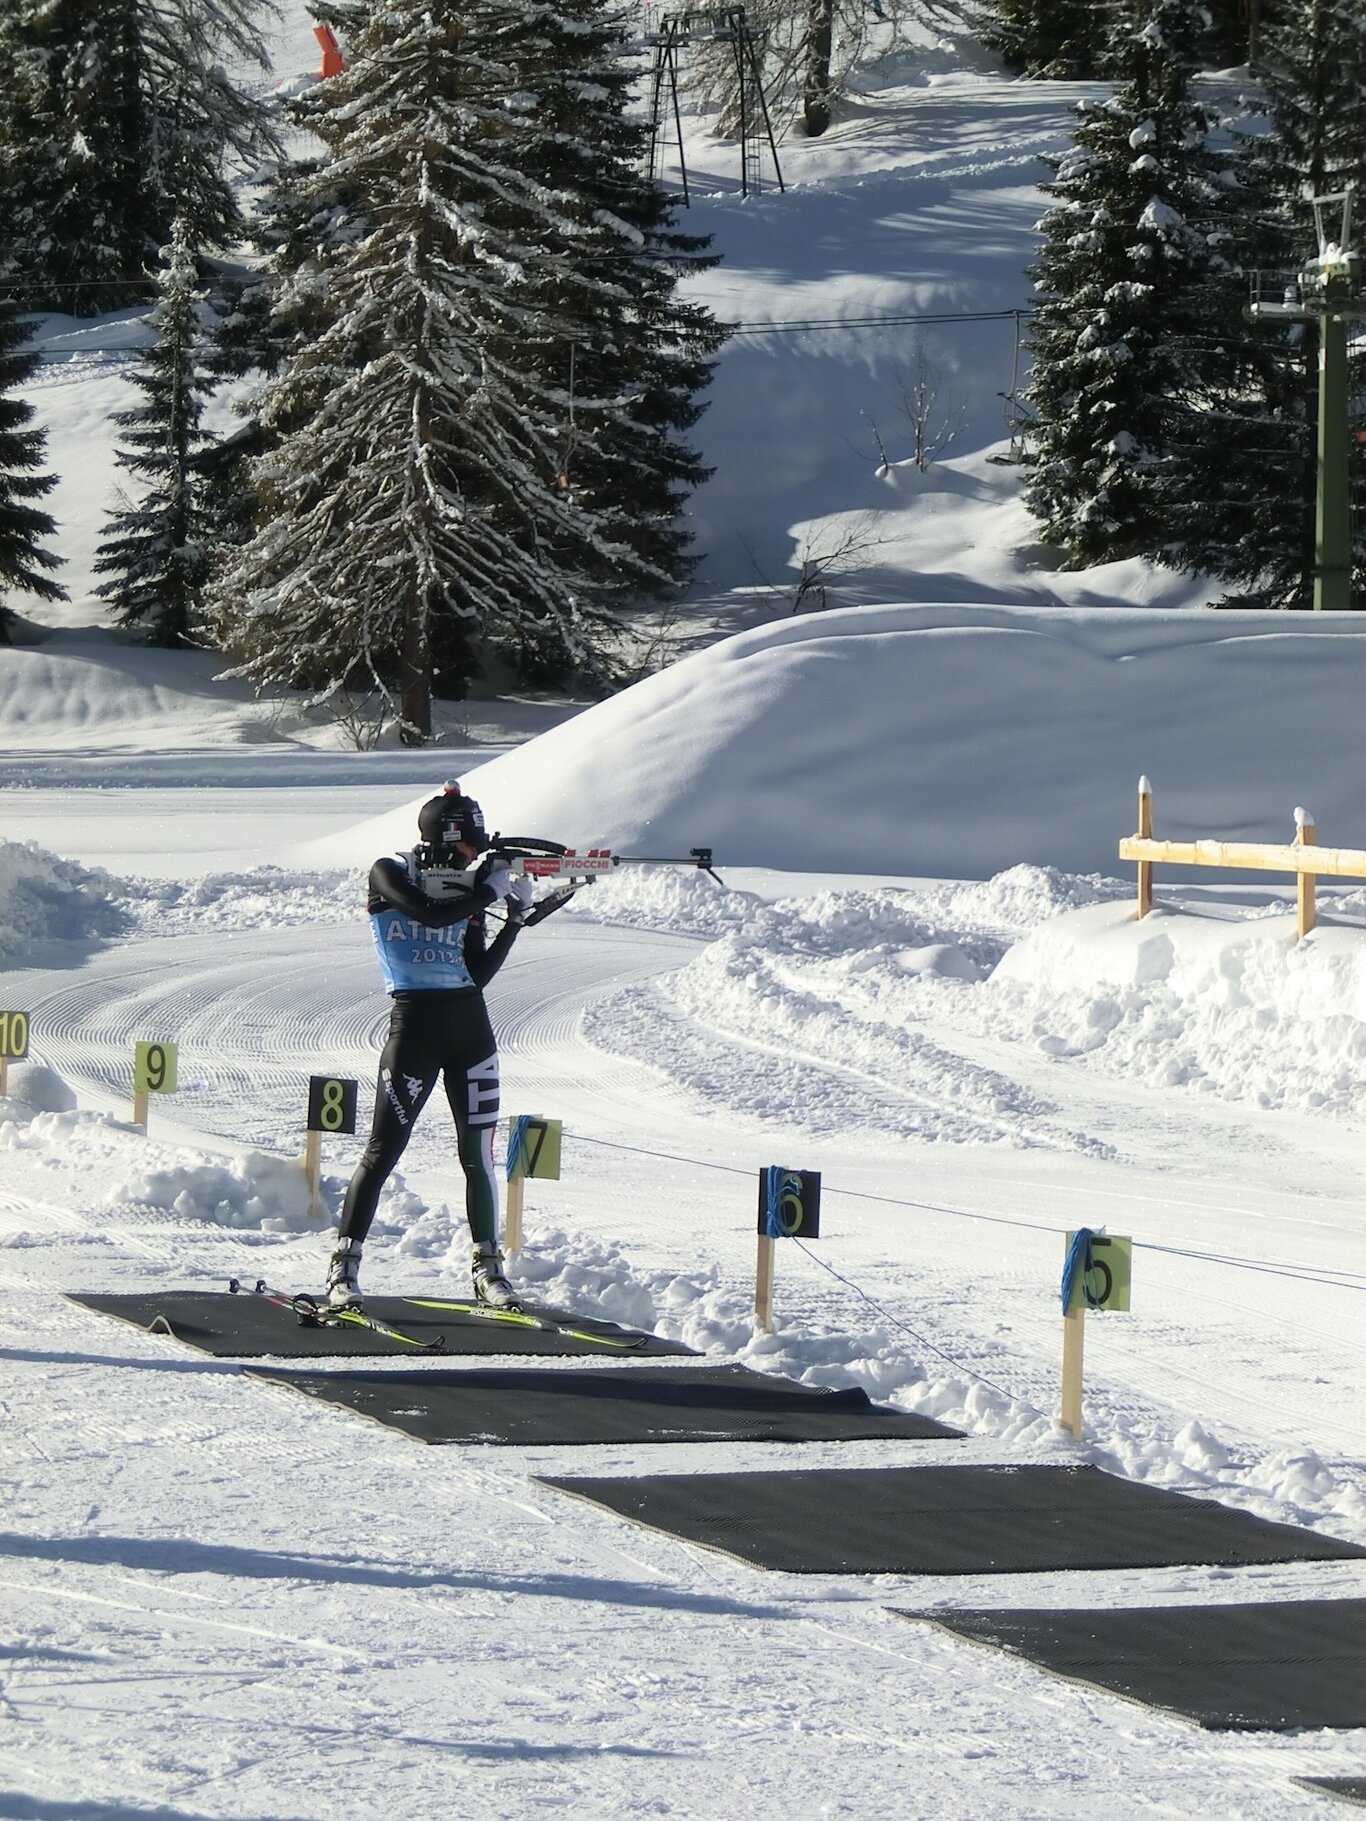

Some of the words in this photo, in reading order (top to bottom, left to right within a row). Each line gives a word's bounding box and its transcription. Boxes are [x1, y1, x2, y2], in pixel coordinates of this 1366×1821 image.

[565, 860, 609, 869] FIOCCHI
[0, 1012, 27, 1056] 10
[146, 1045, 166, 1089] 9
[320, 1080, 344, 1130] 8
[526, 1120, 549, 1177] 7
[777, 1173, 803, 1234] 6
[1083, 1237, 1112, 1305] 5
